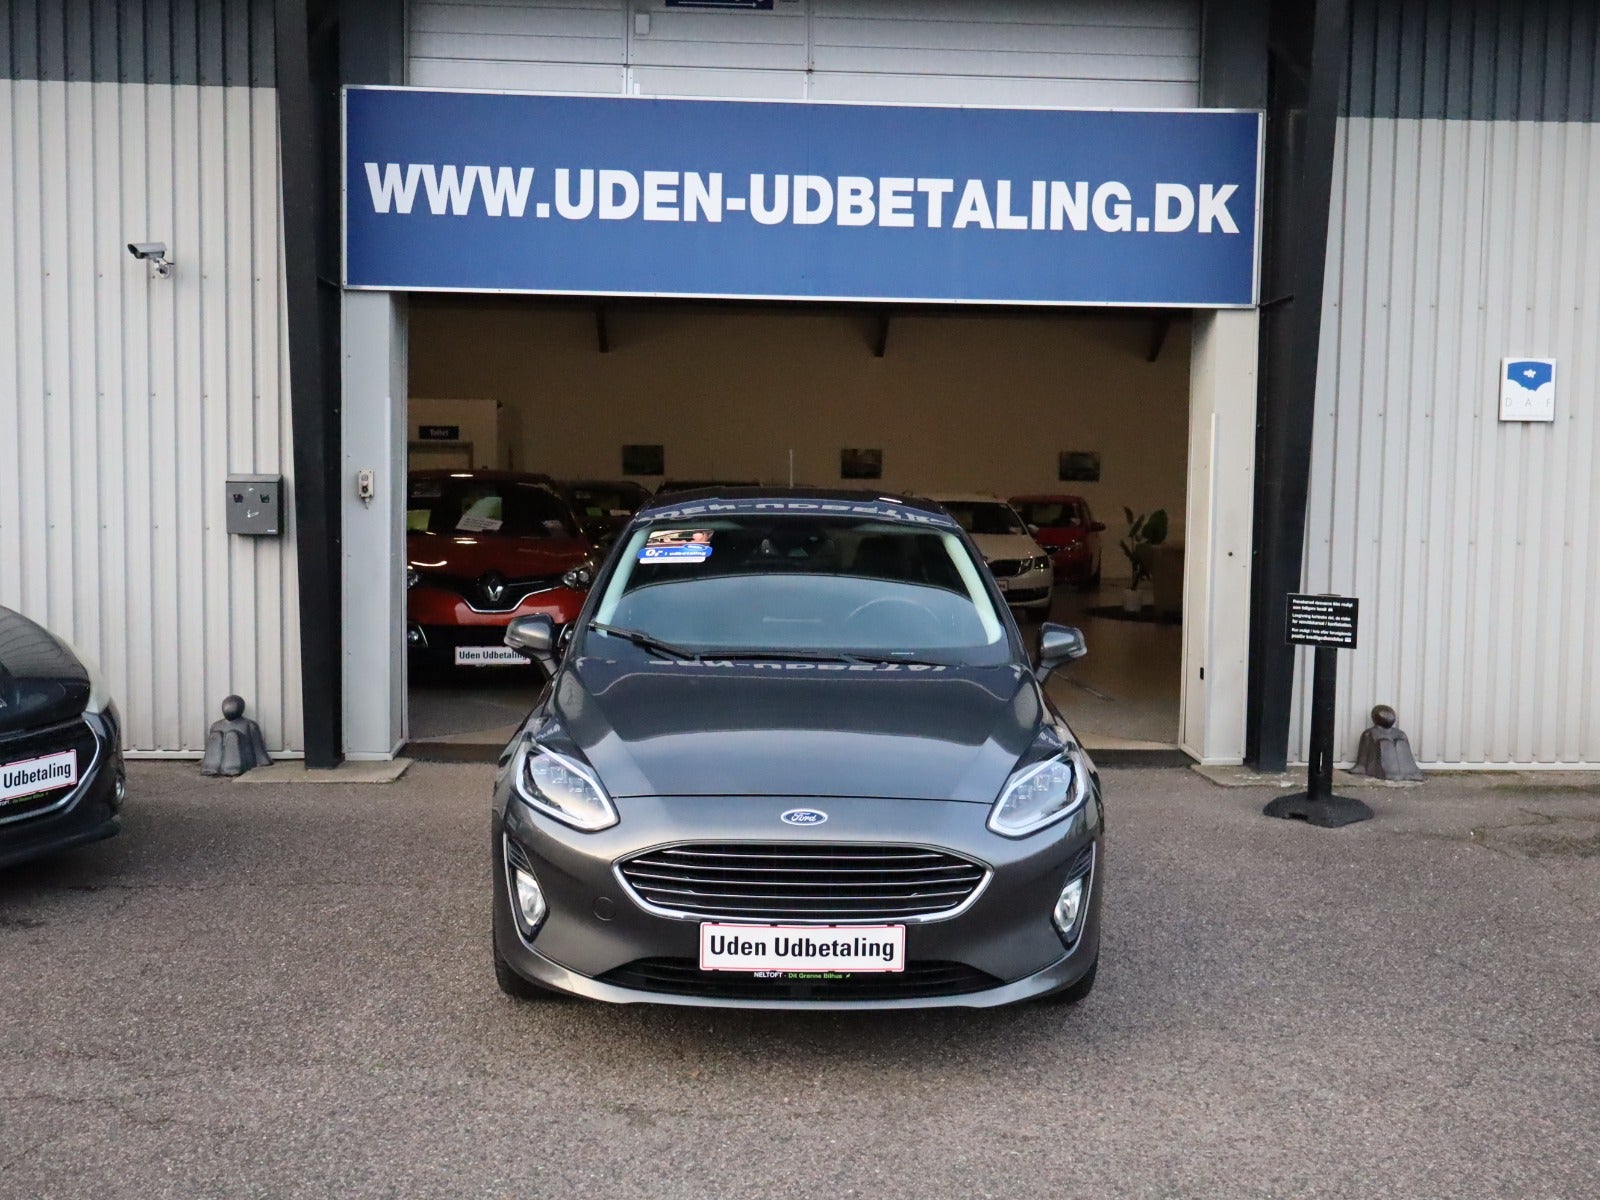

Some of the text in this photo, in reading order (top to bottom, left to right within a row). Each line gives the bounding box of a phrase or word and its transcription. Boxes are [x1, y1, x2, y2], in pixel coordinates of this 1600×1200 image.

[364, 162, 1240, 234] WWW.UDEN-UDBETALING.DK
[459, 651, 480, 659] Uden
[4, 762, 71, 788] Udbetaling
[791, 812, 817, 822] Ford
[710, 935, 895, 961] Uden Udbetaling
